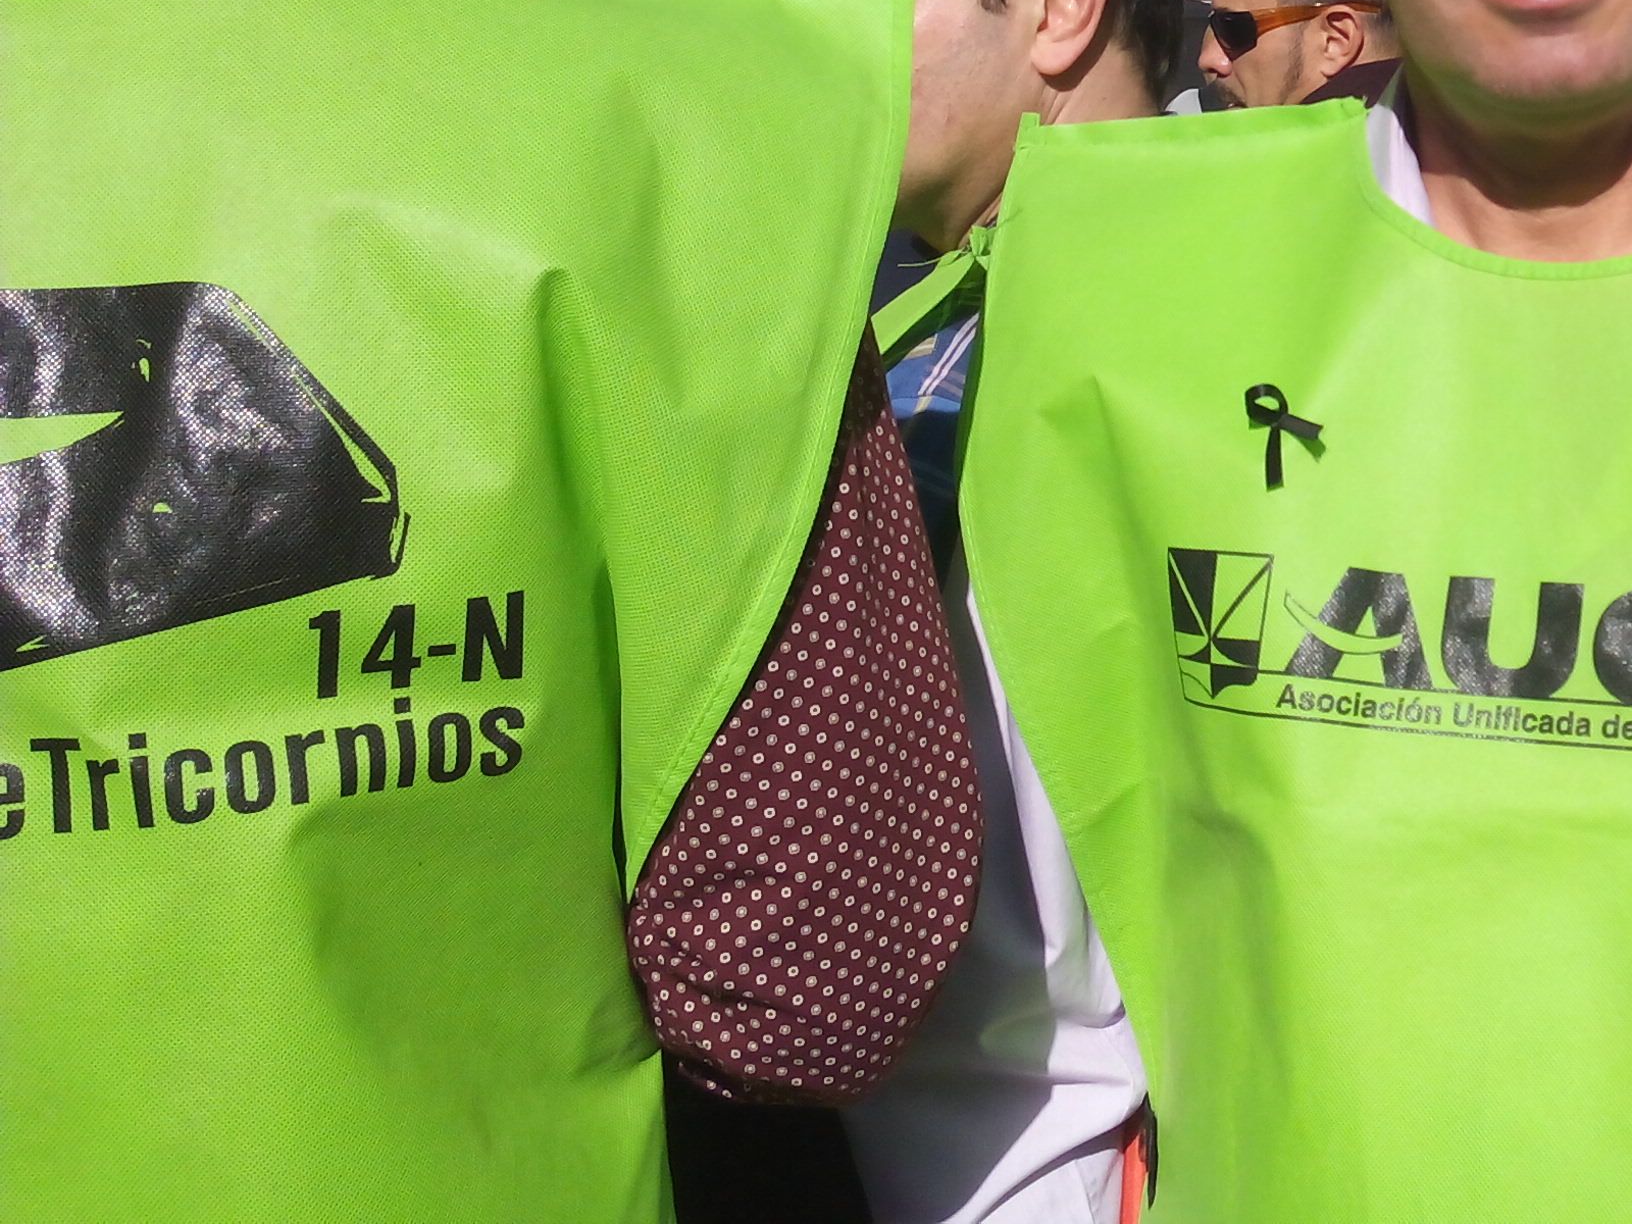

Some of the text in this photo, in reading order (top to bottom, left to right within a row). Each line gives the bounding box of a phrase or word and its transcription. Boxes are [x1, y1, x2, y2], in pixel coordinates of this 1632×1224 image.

[308, 589, 525, 700] 14-N
[1276, 682, 1442, 726] Asociación
[1453, 700, 1592, 739] Unificada
